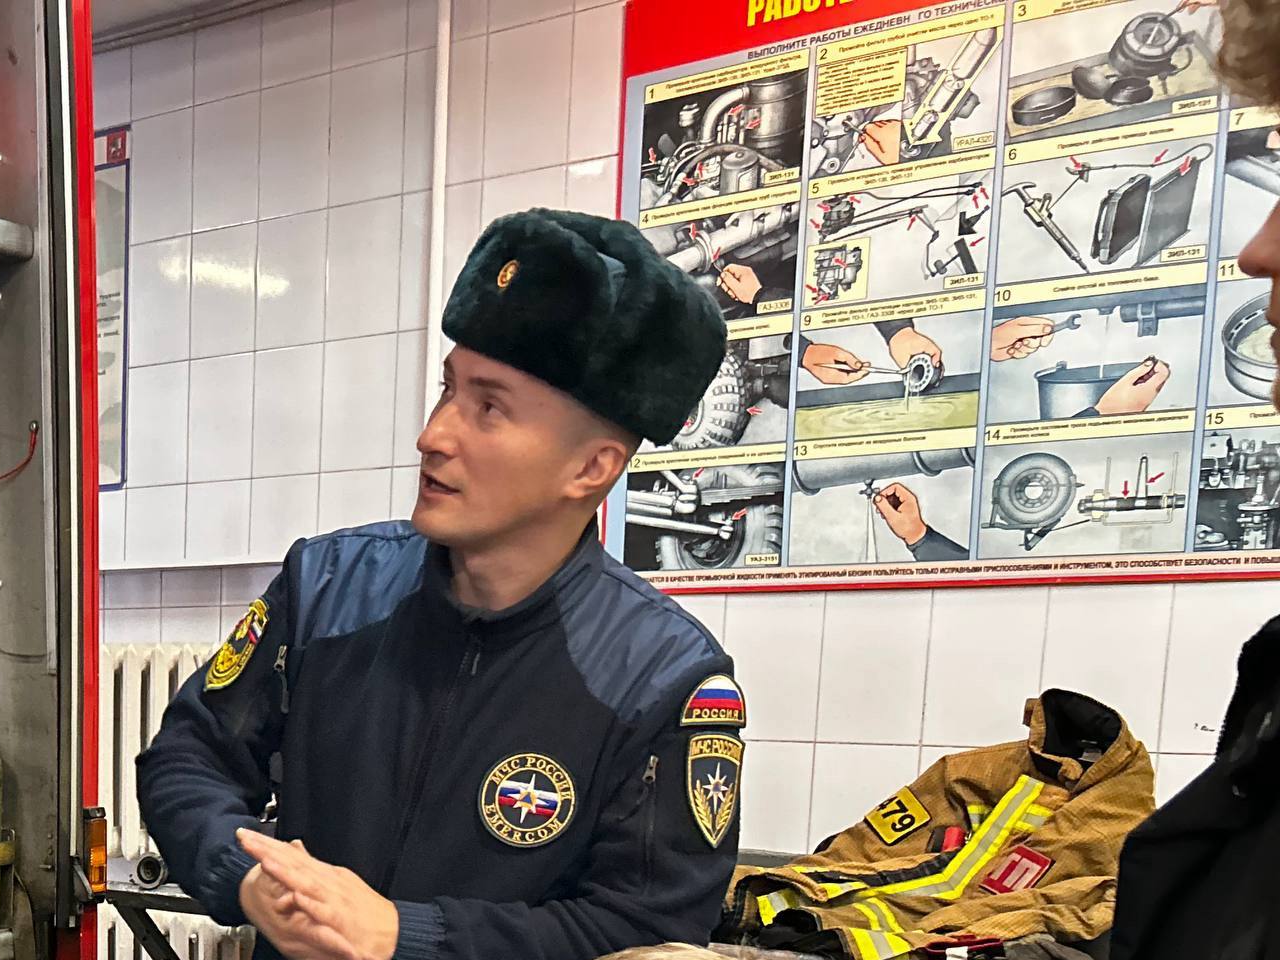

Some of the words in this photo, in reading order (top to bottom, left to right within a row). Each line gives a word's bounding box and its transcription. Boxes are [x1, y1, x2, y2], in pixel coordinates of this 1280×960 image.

[1018, 5, 1026, 16] 3
[747, 38, 807, 60] ВЫПОЛНИТЕ
[809, 29, 850, 46] РАБОТЫ
[820, 49, 827, 60] 2
[650, 88, 654, 98] 1
[1236, 113, 1243, 124] 7
[1008, 149, 1017, 160] 6
[812, 183, 819, 194] 5
[642, 211, 649, 223] 4
[1220, 264, 1235, 276] 11
[950, 276, 979, 285] ЗИЛ-131
[995, 290, 1011, 302] 10
[804, 315, 811, 326] 9
[1207, 413, 1223, 425] 15
[985, 430, 1000, 441] 14
[794, 446, 807, 456] 13
[1130, 559, 1183, 567] СПОСОБСТВУЕТ
[1184, 558, 1241, 566] БЕЗОПАСНОСТИ
[692, 708, 739, 720] РОССИЯ
[491, 759, 520, 785] МЧС
[525, 756, 573, 800] РОССИИ
[485, 803, 564, 842] EMERCOM
